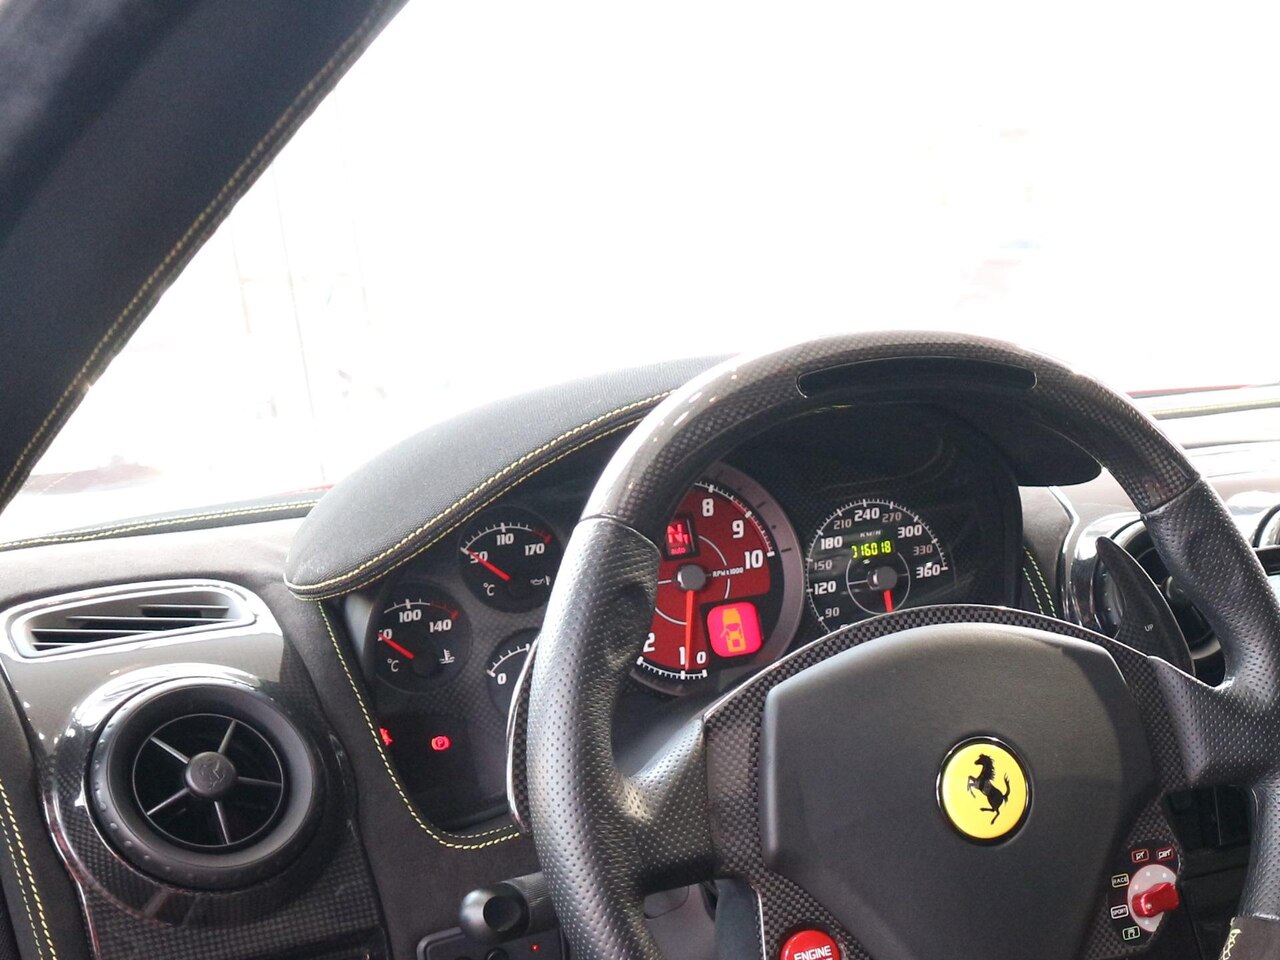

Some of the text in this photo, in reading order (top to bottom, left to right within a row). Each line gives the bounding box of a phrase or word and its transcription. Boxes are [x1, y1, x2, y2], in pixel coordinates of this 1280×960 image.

[702, 498, 714, 517] 8
[854, 508, 880, 522] 240
[882, 511, 902, 523] 270
[732, 519, 745, 539] 9
[833, 519, 852, 531] 210
[897, 525, 923, 539] 300
[496, 533, 515, 546] 110
[820, 535, 843, 550] 180
[524, 543, 545, 556] 170
[913, 544, 933, 556] 330
[744, 549, 764, 569] 10
[814, 560, 832, 571] 150
[916, 564, 941, 579] 360
[814, 581, 837, 596] 120
[399, 609, 422, 623] 100
[825, 606, 840, 618] 90
[429, 619, 452, 633] 140
[1144, 623, 1154, 632] UP
[643, 633, 655, 653] 2
[679, 646, 686, 665] 1
[696, 651, 707, 664] 0
[497, 673, 507, 685] 0
[1114, 876, 1128, 884] RACE
[1112, 906, 1127, 915] SPORT
